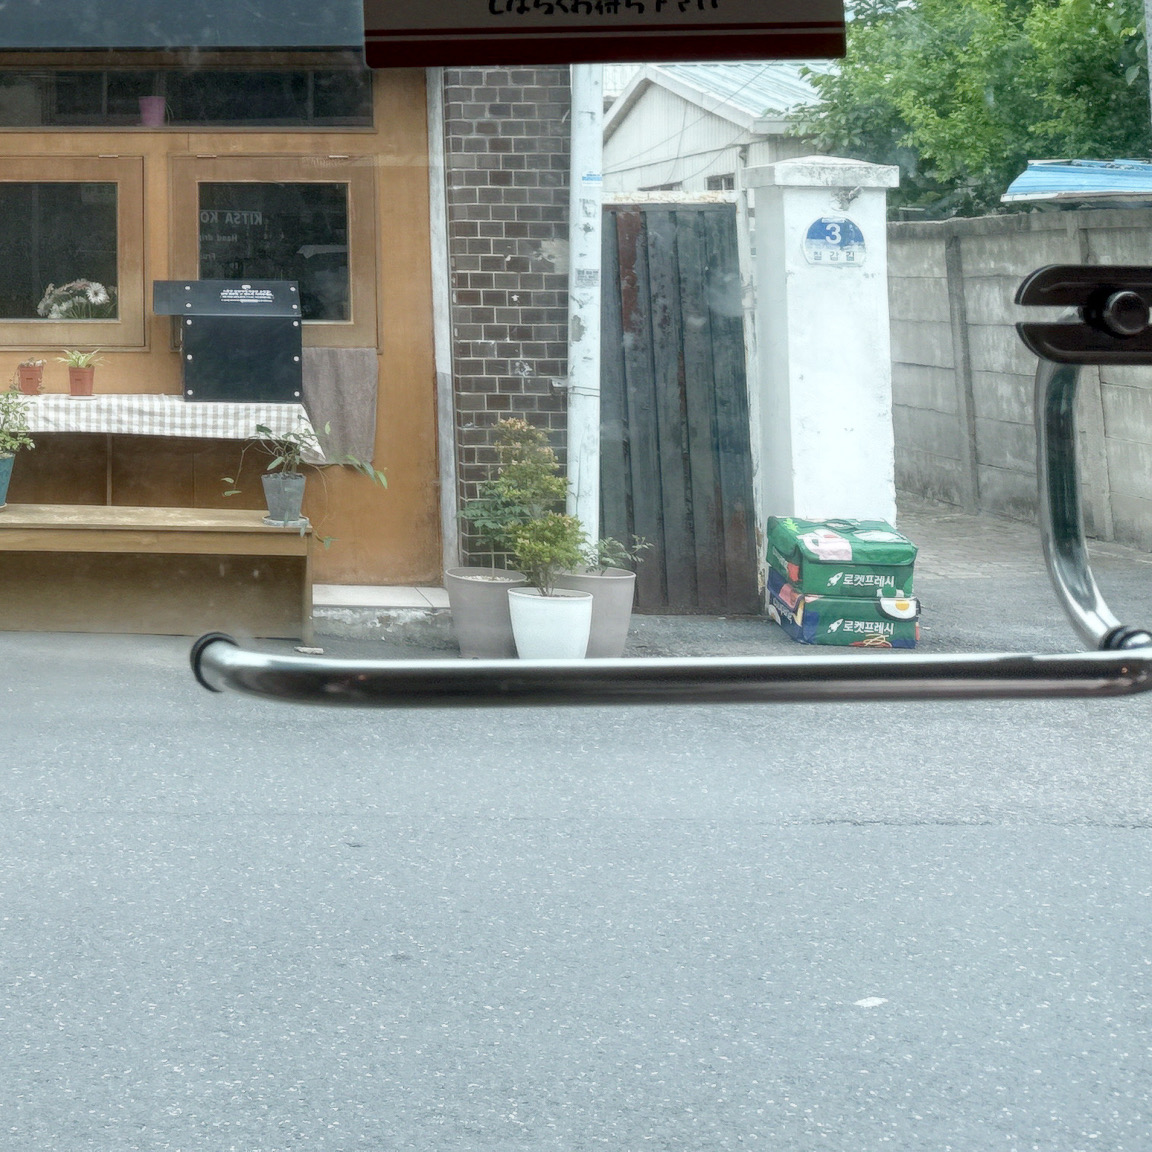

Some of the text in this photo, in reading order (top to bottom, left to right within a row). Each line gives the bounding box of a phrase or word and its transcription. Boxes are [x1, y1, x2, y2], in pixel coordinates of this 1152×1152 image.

[825, 223, 841, 244] 3
[842, 573, 895, 588] 로켓프레시
[842, 620, 895, 635] 로켓프레시
